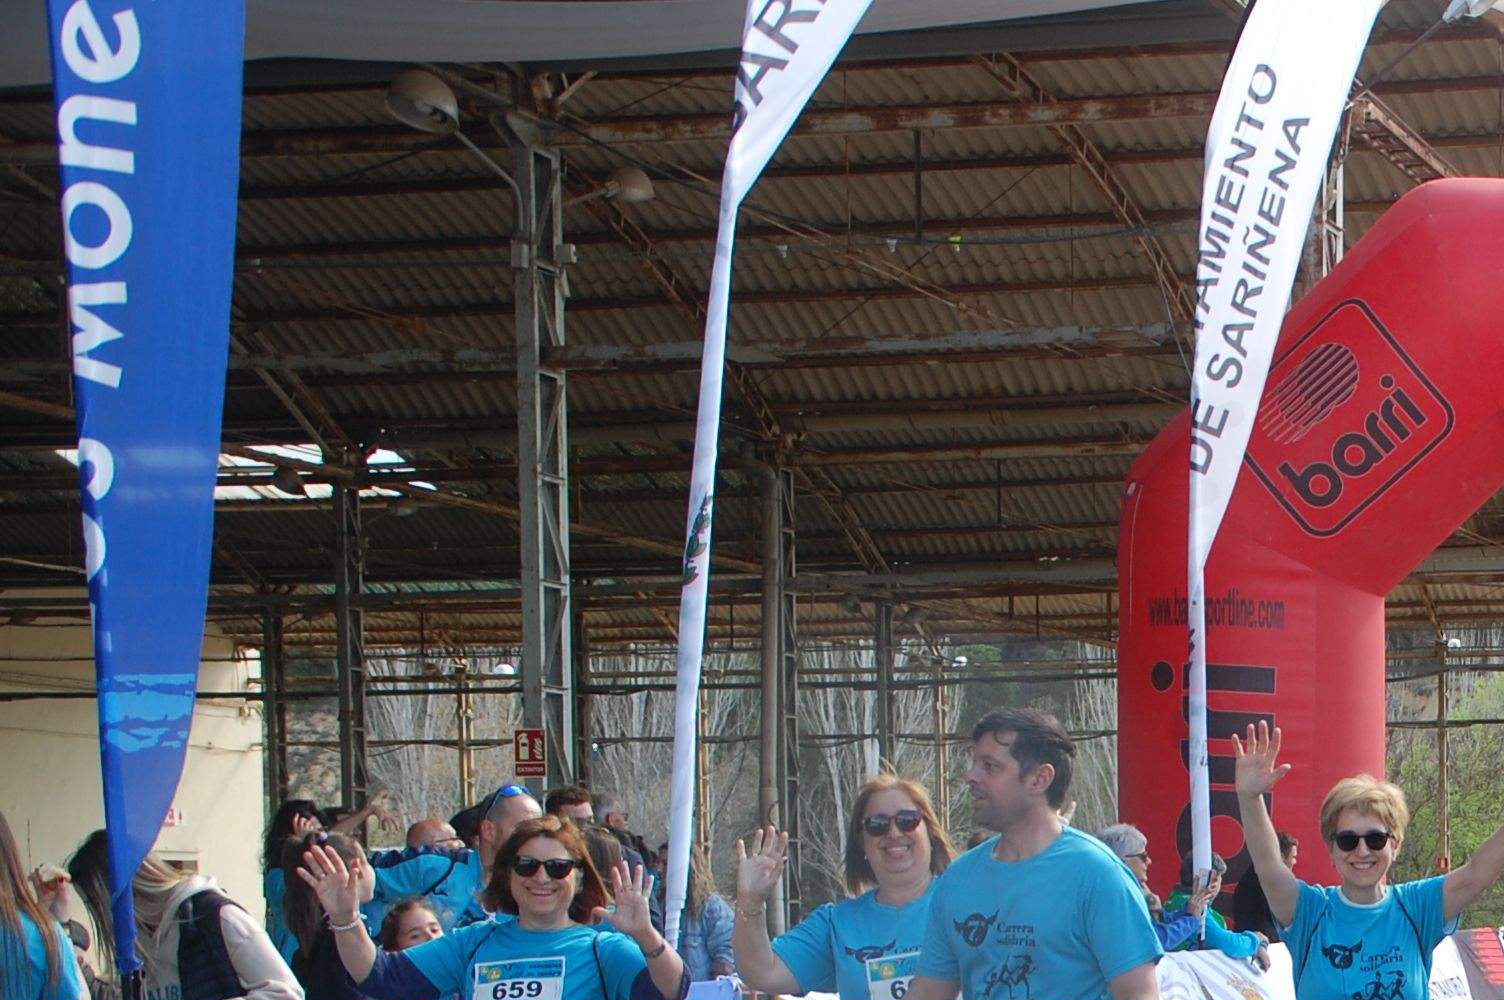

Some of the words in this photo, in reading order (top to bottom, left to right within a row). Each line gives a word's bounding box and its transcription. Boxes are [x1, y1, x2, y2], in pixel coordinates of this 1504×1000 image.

[1195, 62, 1278, 331] AMIENTO
[1206, 115, 1311, 389] SARIÑENA
[1276, 372, 1429, 509] barri
[492, 980, 543, 1000] 659
